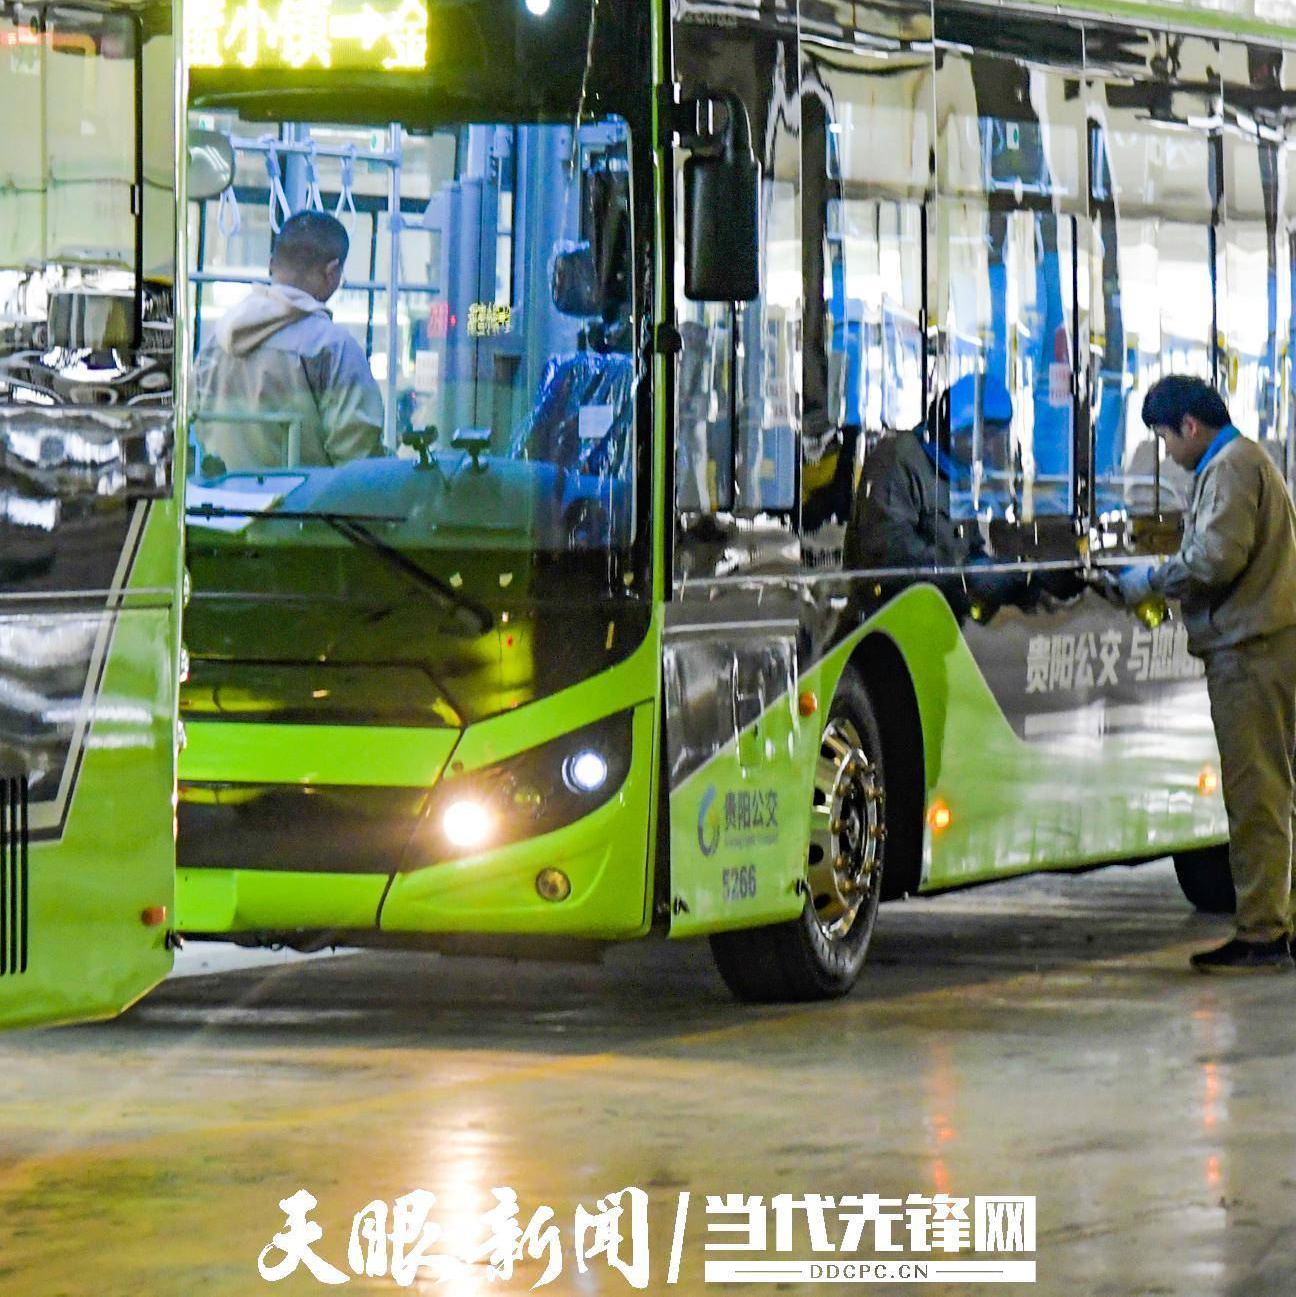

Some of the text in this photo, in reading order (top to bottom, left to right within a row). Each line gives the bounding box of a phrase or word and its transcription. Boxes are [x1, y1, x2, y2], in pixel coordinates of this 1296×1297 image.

[1025, 621, 1205, 693] 贵阳公交 与您相
